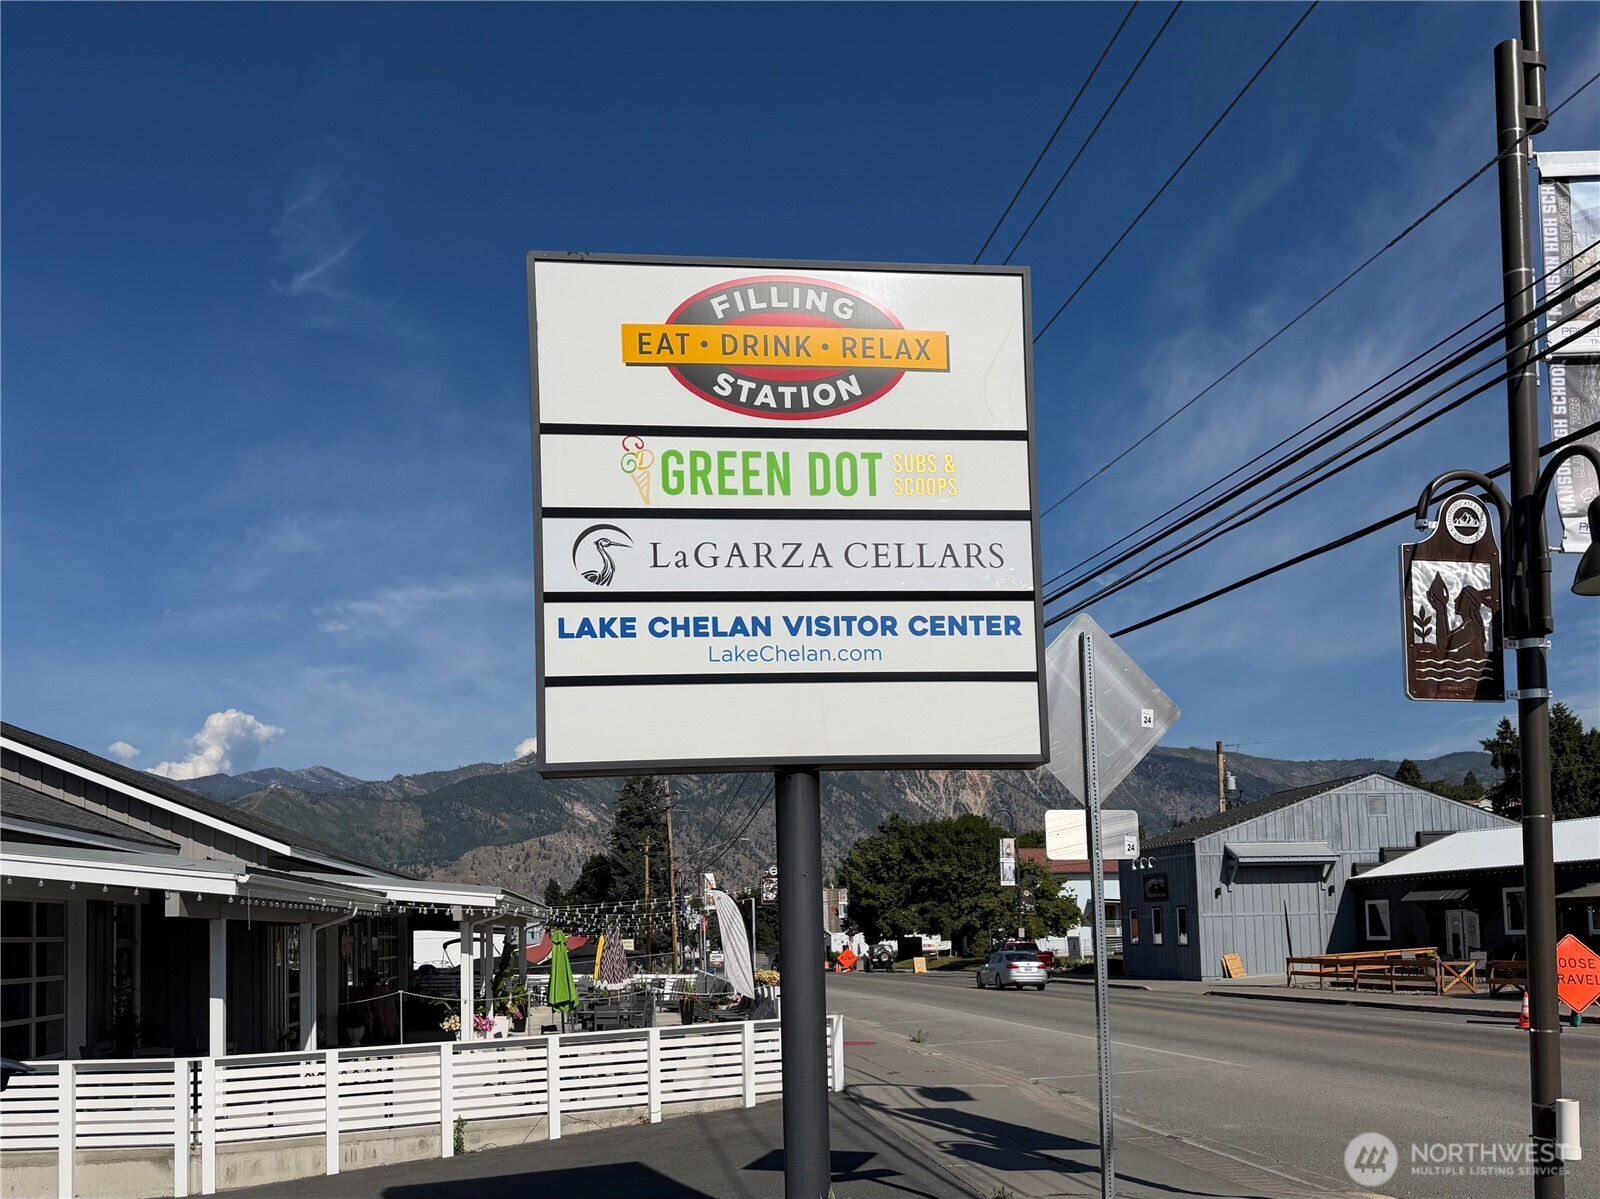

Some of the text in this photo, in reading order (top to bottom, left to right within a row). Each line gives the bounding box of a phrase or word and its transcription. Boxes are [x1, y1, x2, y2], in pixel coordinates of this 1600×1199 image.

[1559, 197, 1570, 223] 2026
[1543, 218, 1559, 251] HIGH
[1560, 226, 1573, 242] OF
[1545, 256, 1563, 316] MNSON
[710, 286, 855, 321] FILLING
[637, 332, 932, 361] EAT DRINK RELAX
[712, 372, 863, 409] STATION
[1569, 398, 1581, 425] 2026
[660, 449, 882, 497] GREEN DOT
[892, 453, 957, 475] SUBS &
[893, 477, 958, 497] SCOOPS
[649, 541, 1005, 569] LaGARZA CELLARS
[558, 615, 1023, 639] LAKE CHELAN VISITOR CENTER
[708, 645, 883, 663] LakeChelan.com
[1143, 716, 1152, 724] 24
[1127, 843, 1135, 852] 24
[1558, 957, 1597, 969] OOSE
[1557, 974, 1600, 986] RAVEL
